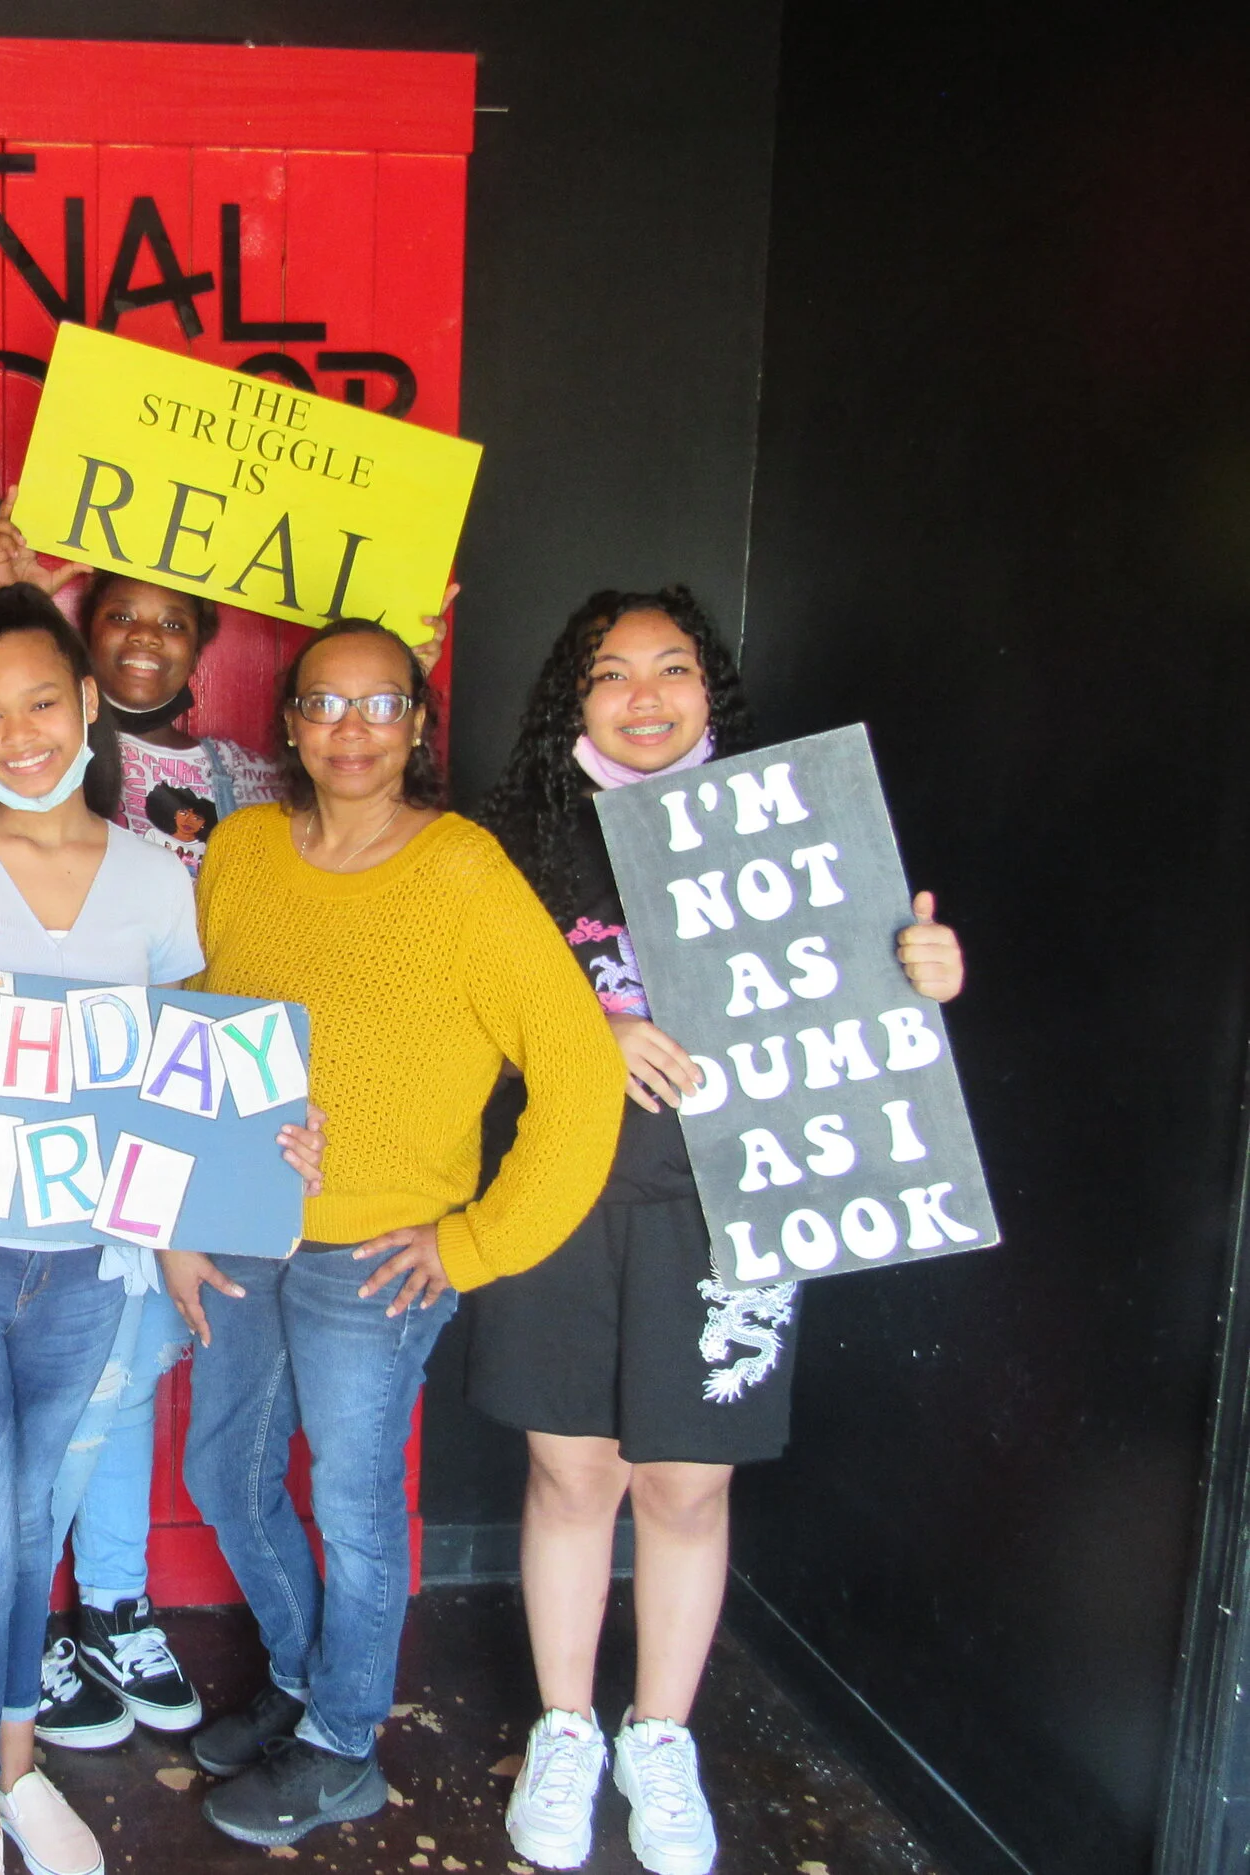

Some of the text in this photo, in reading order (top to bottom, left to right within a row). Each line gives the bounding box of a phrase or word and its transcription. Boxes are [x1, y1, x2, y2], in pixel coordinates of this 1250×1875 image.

[138, 394, 374, 489] STRUGGLE
[227, 379, 312, 432] THE
[230, 459, 269, 495] IS
[56, 454, 387, 625] REAL
[660, 763, 809, 852] I'M
[667, 842, 844, 939] NOT
[725, 936, 838, 1017] AS
[680, 1007, 940, 1115] DUMB
[738, 1100, 926, 1192] AS I
[725, 1182, 978, 1281] LOOK
